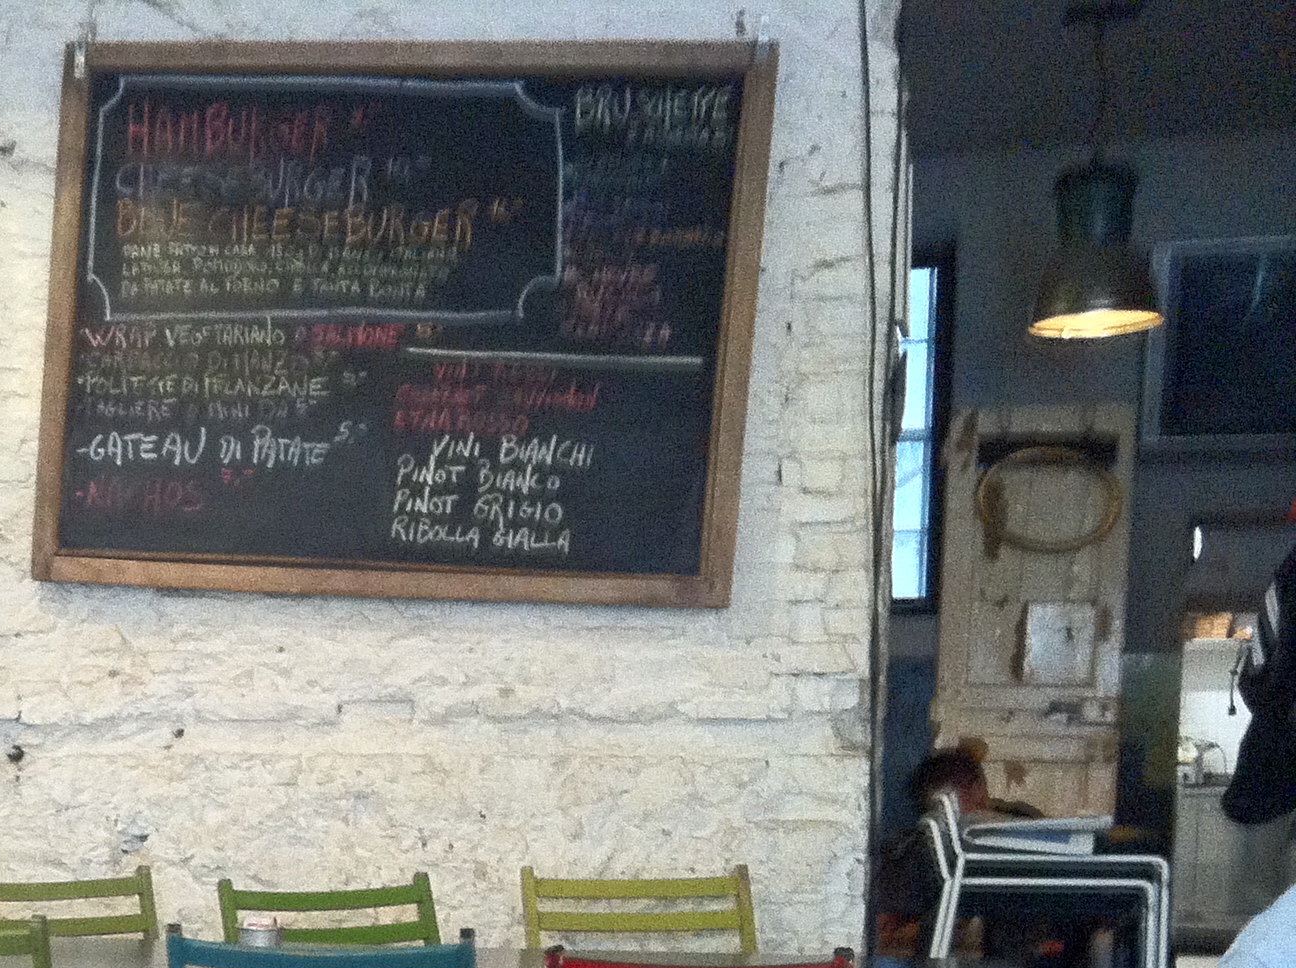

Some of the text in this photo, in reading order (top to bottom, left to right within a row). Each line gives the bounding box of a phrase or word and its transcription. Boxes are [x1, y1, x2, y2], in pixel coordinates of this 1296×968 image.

[219, 434, 242, 465] DI
[252, 424, 330, 469] PATATE
[432, 431, 595, 468] VINI BIANCHI
[397, 453, 561, 495] PINOT BIANCO
[393, 486, 564, 526] PINOT GRIGIO
[390, 515, 572, 556] RIBOLLA GIALLA
